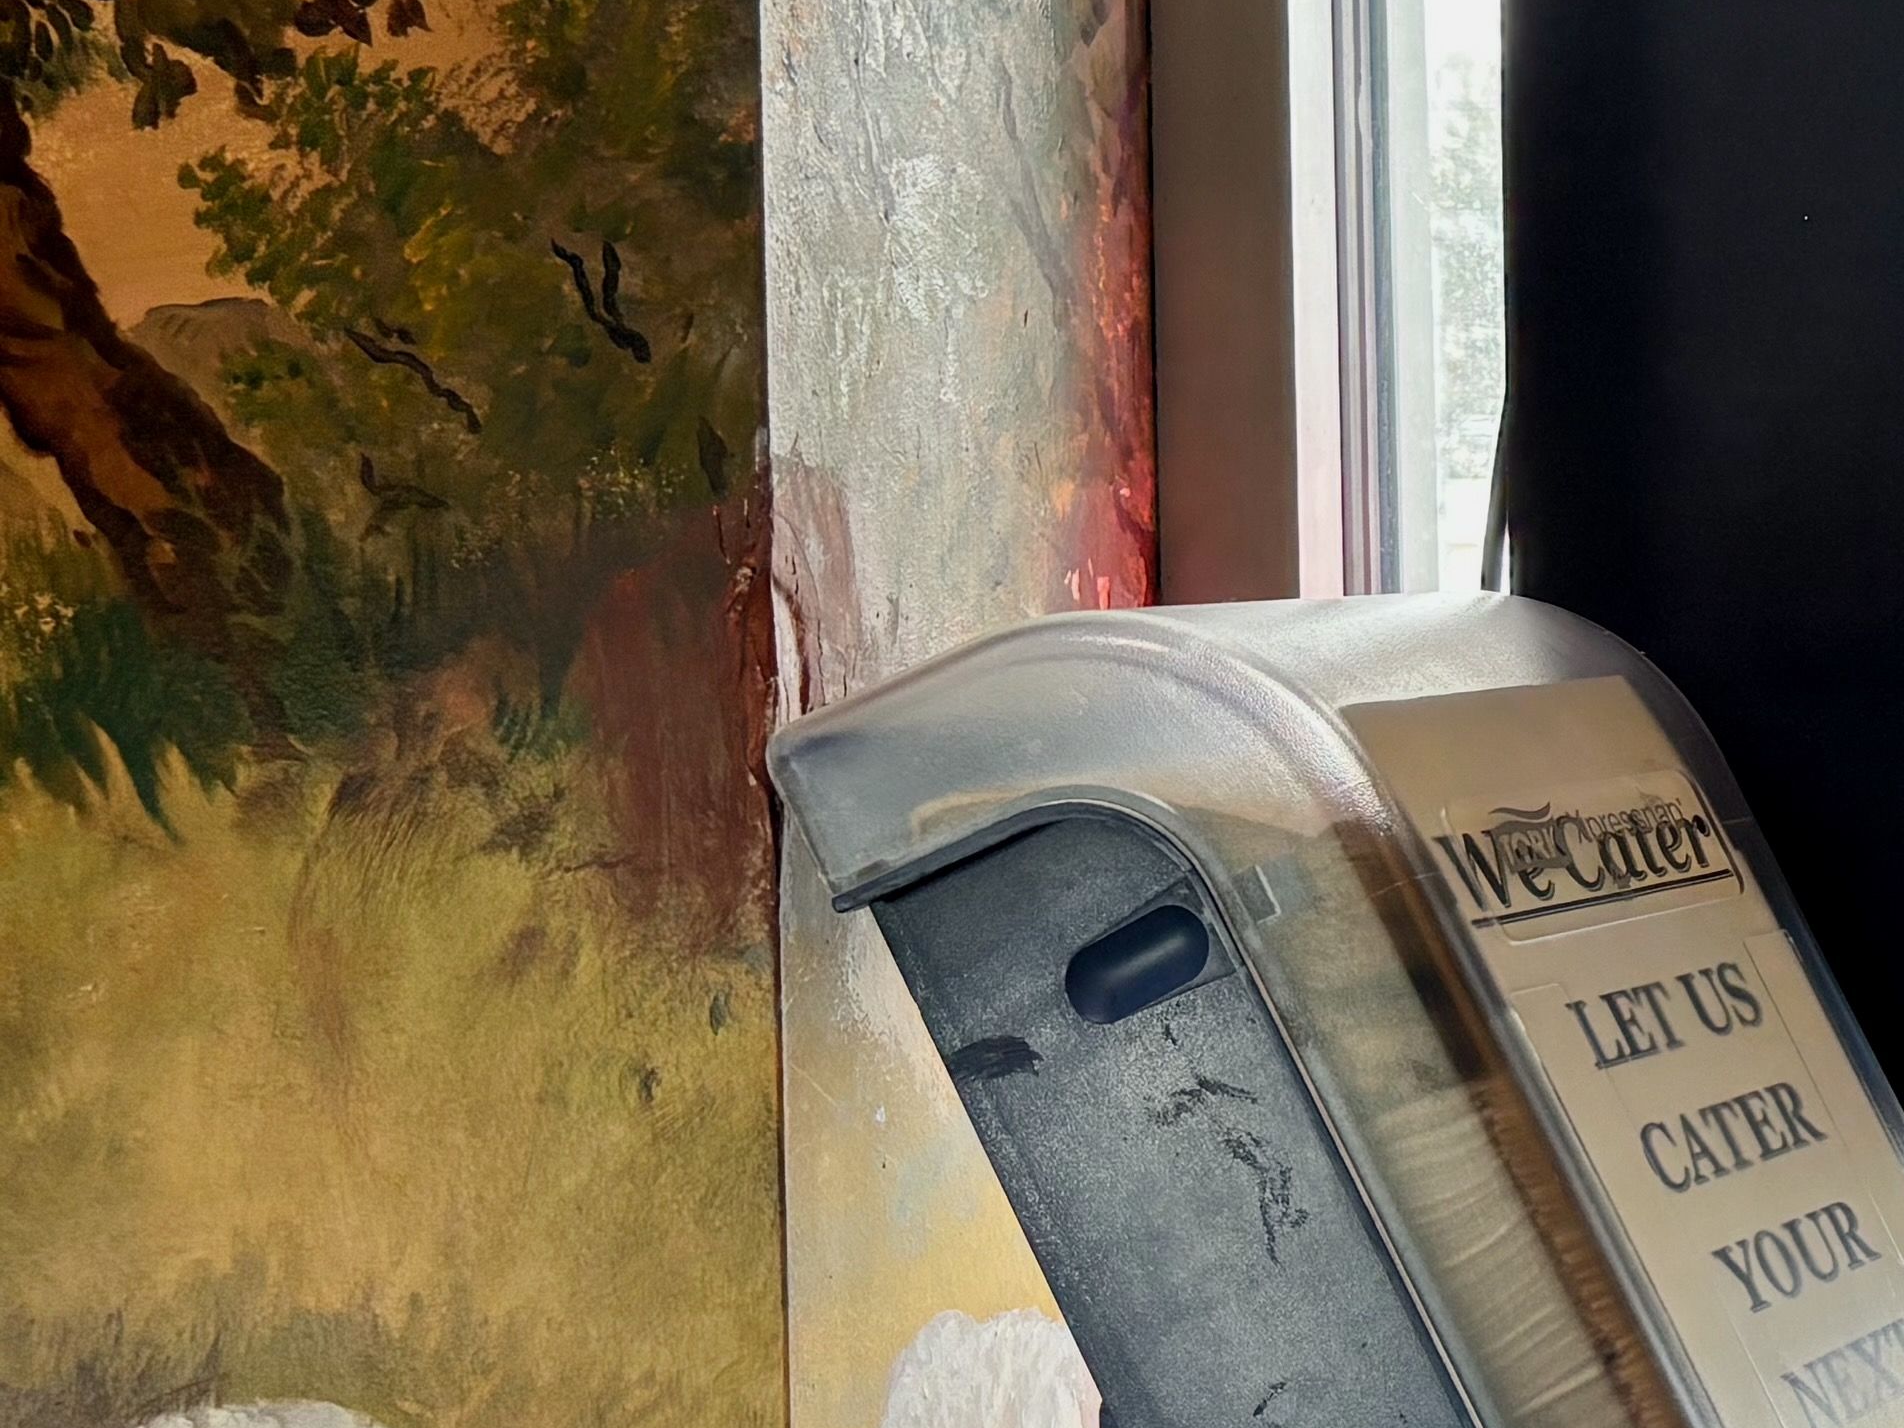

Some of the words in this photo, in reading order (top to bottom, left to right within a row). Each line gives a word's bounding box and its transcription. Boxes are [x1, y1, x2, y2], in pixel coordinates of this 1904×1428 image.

[1565, 981, 1685, 1070] LET
[1674, 962, 1763, 1036] US
[1639, 1082, 1828, 1193] CATER
[1712, 1202, 1882, 1313] YOUR
